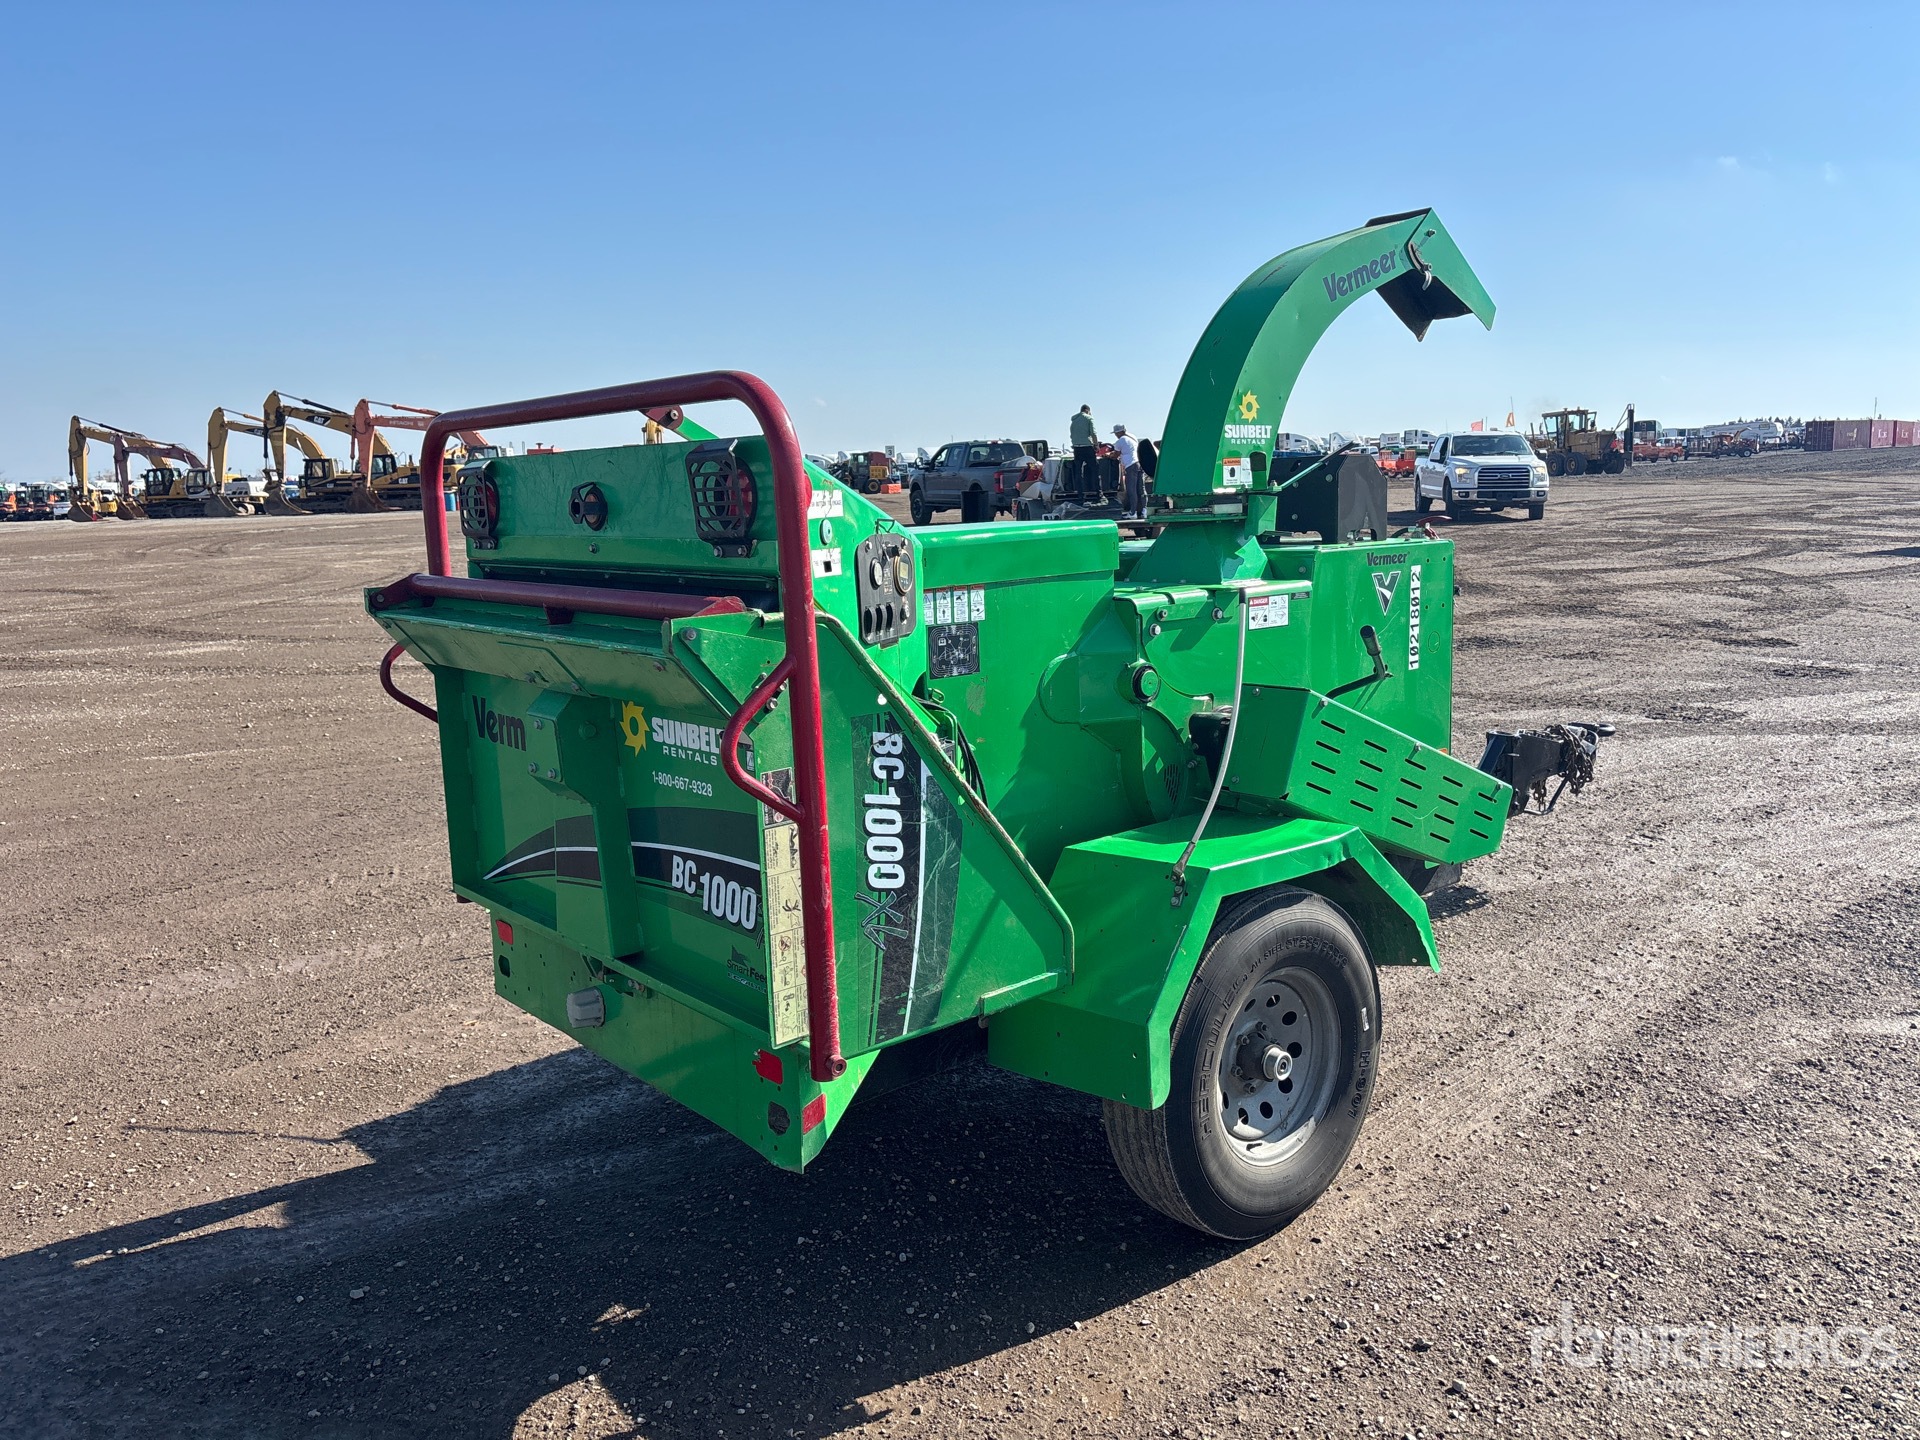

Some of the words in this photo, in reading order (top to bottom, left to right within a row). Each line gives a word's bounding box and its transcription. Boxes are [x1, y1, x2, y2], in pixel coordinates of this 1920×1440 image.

[1322, 249, 1397, 303] Vermeer
[313, 415, 325, 424] CAT
[1224, 424, 1273, 439] SUNBELT
[1366, 552, 1408, 567] Vermeer
[1409, 568, 1421, 669] 10218012
[471, 694, 527, 752] Verm
[662, 745, 718, 767] RENTALS
[872, 731, 905, 780] BC
[652, 770, 713, 797] 1-800-667-9328
[864, 786, 906, 889] 1000
[671, 854, 697, 895] BC
[700, 871, 758, 931] 1000
[727, 959, 766, 984] SmartFee
